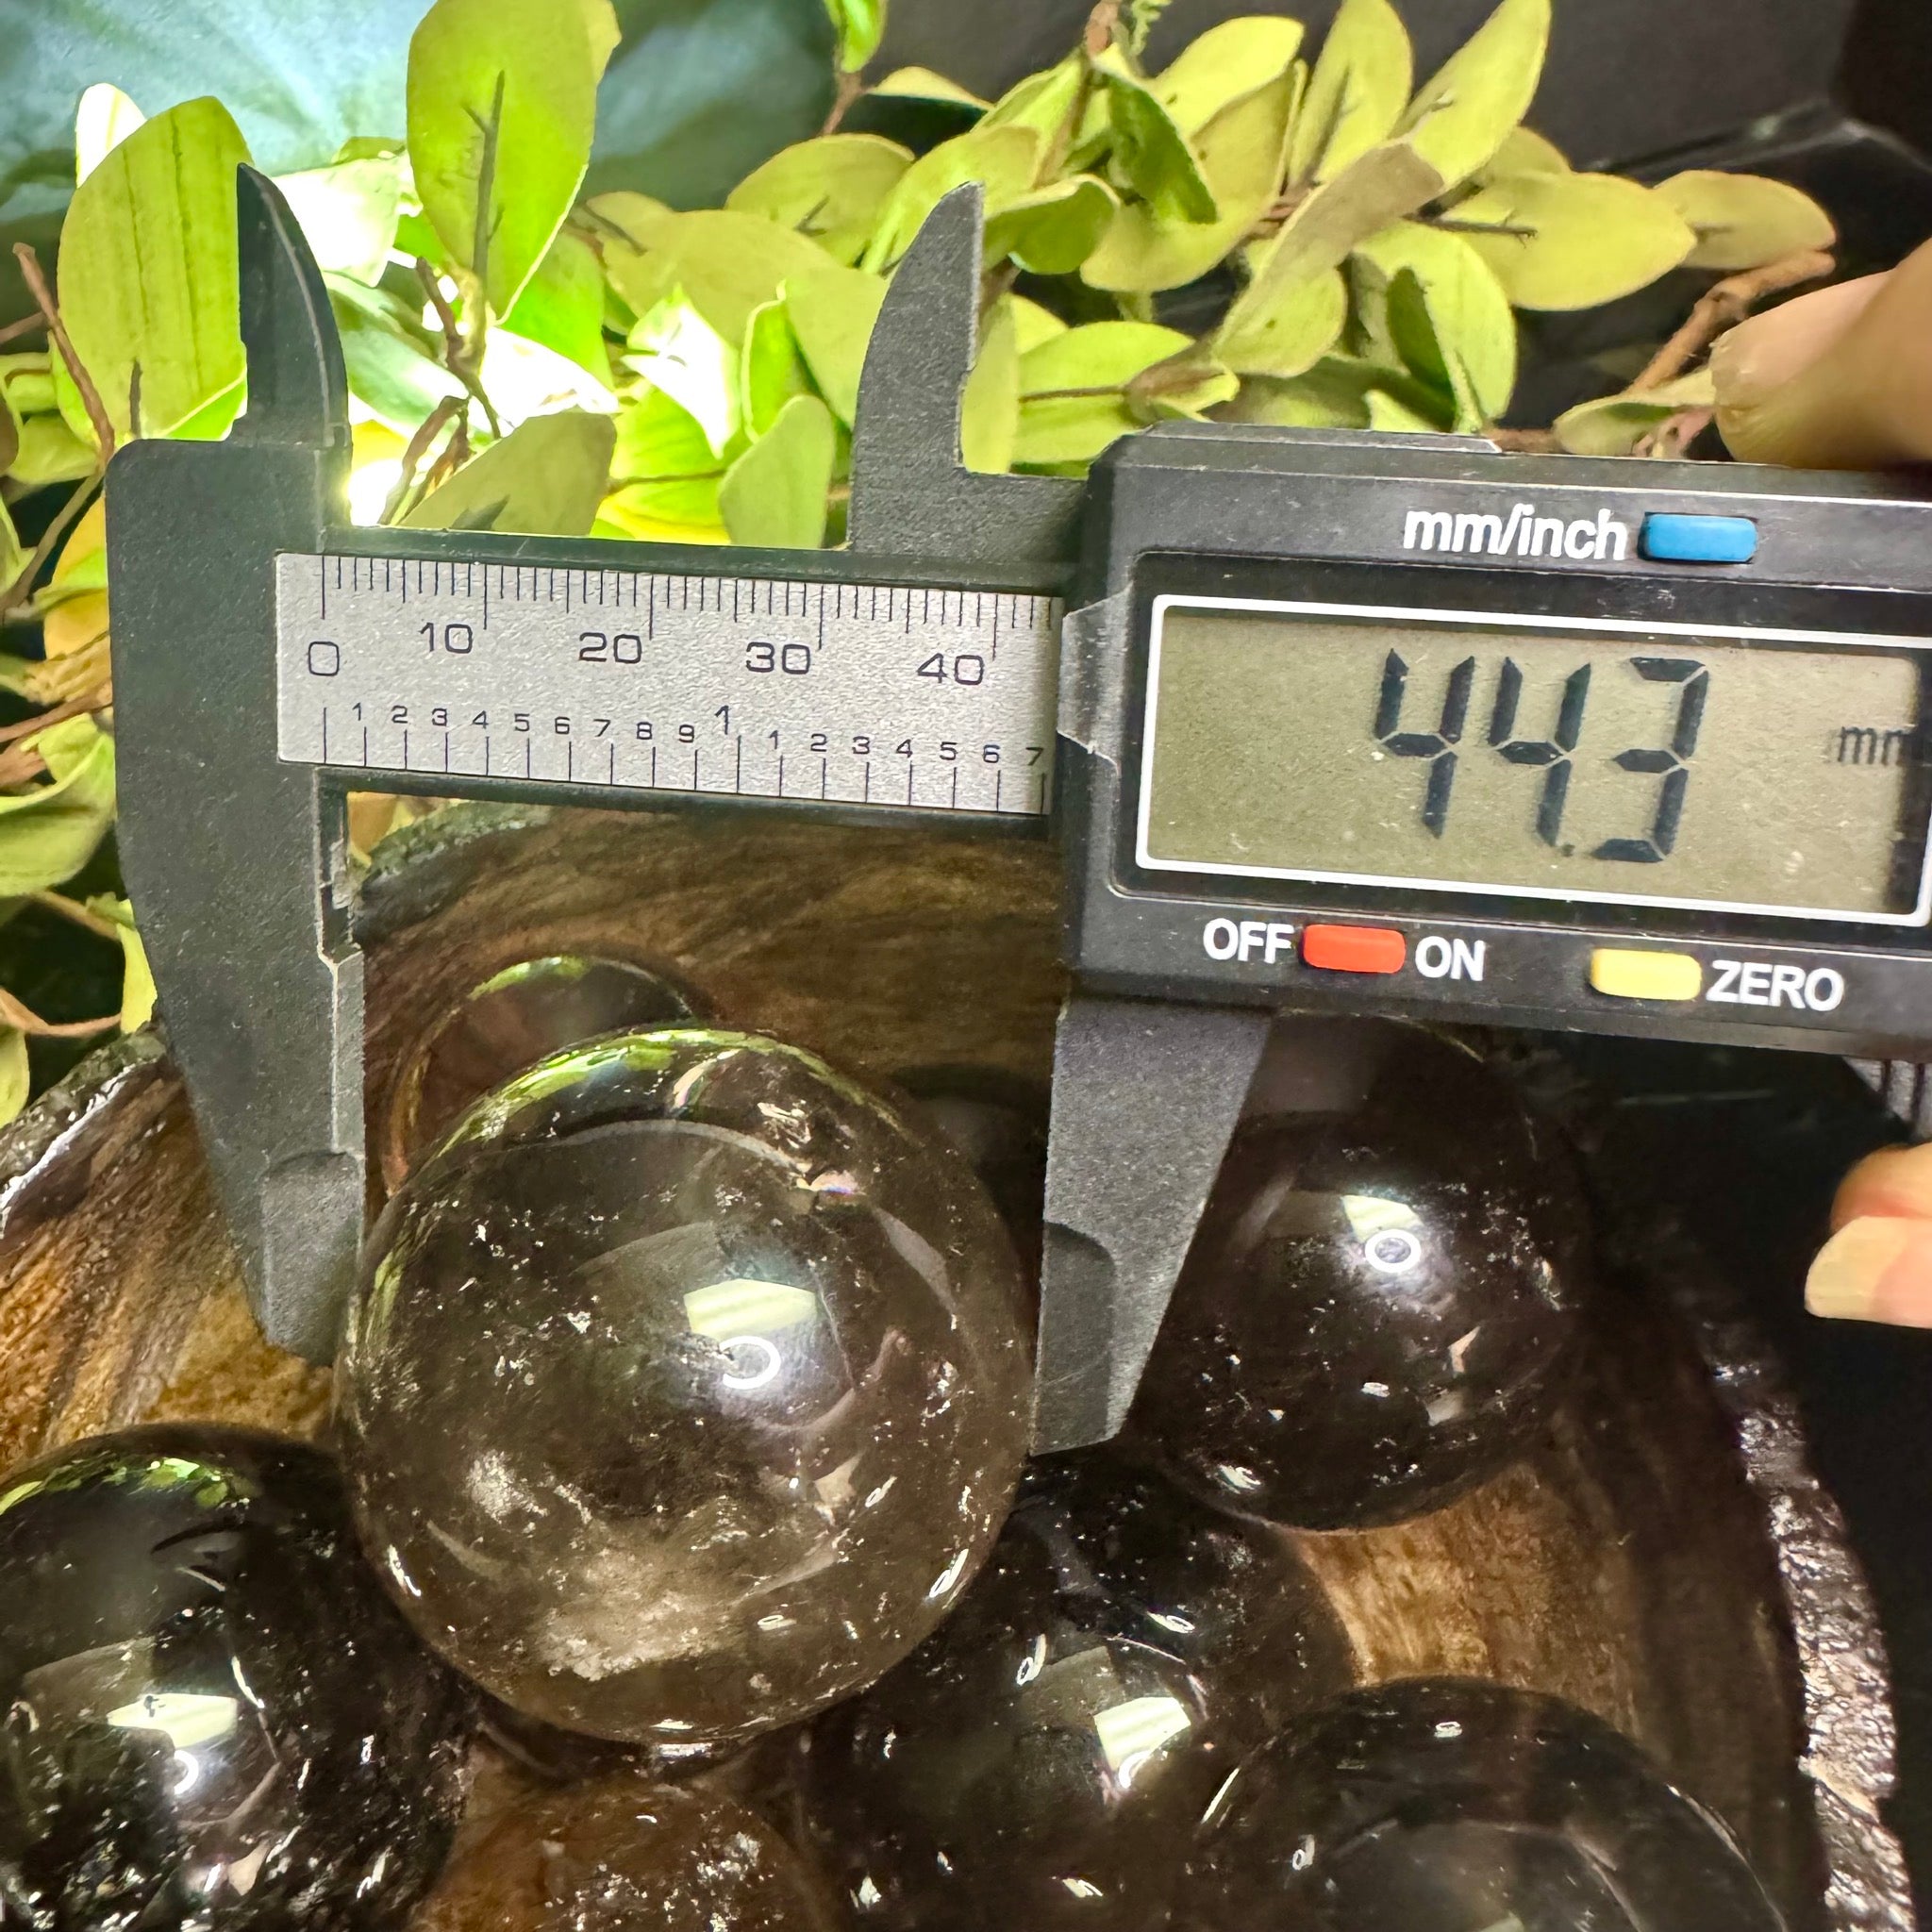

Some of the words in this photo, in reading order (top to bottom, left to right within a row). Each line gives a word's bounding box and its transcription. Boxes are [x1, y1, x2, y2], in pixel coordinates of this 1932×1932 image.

[1402, 504, 1628, 560] mm/inch
[308, 641, 340, 675] 0
[418, 622, 472, 654] 10
[579, 632, 642, 664] 20
[746, 641, 811, 675] 30
[917, 653, 984, 685] 40
[352, 703, 361, 721] 1
[391, 706, 408, 724] 2
[431, 708, 448, 726] 3
[473, 710, 489, 729] 4
[514, 713, 530, 732] 5
[555, 716, 570, 735] 6
[593, 719, 610, 737] 7
[636, 721, 652, 740] 8
[678, 724, 695, 743] 9
[715, 706, 729, 735] 1
[769, 730, 778, 749] 1
[810, 734, 826, 752] 2
[852, 737, 870, 755] 3
[896, 739, 913, 758] 4
[940, 742, 958, 760] 5
[983, 745, 1000, 763] 6
[1025, 747, 1043, 766] 7
[1203, 918, 1294, 964] OFF
[1414, 936, 1486, 981] ON
[1707, 960, 1844, 1011] ZERO
